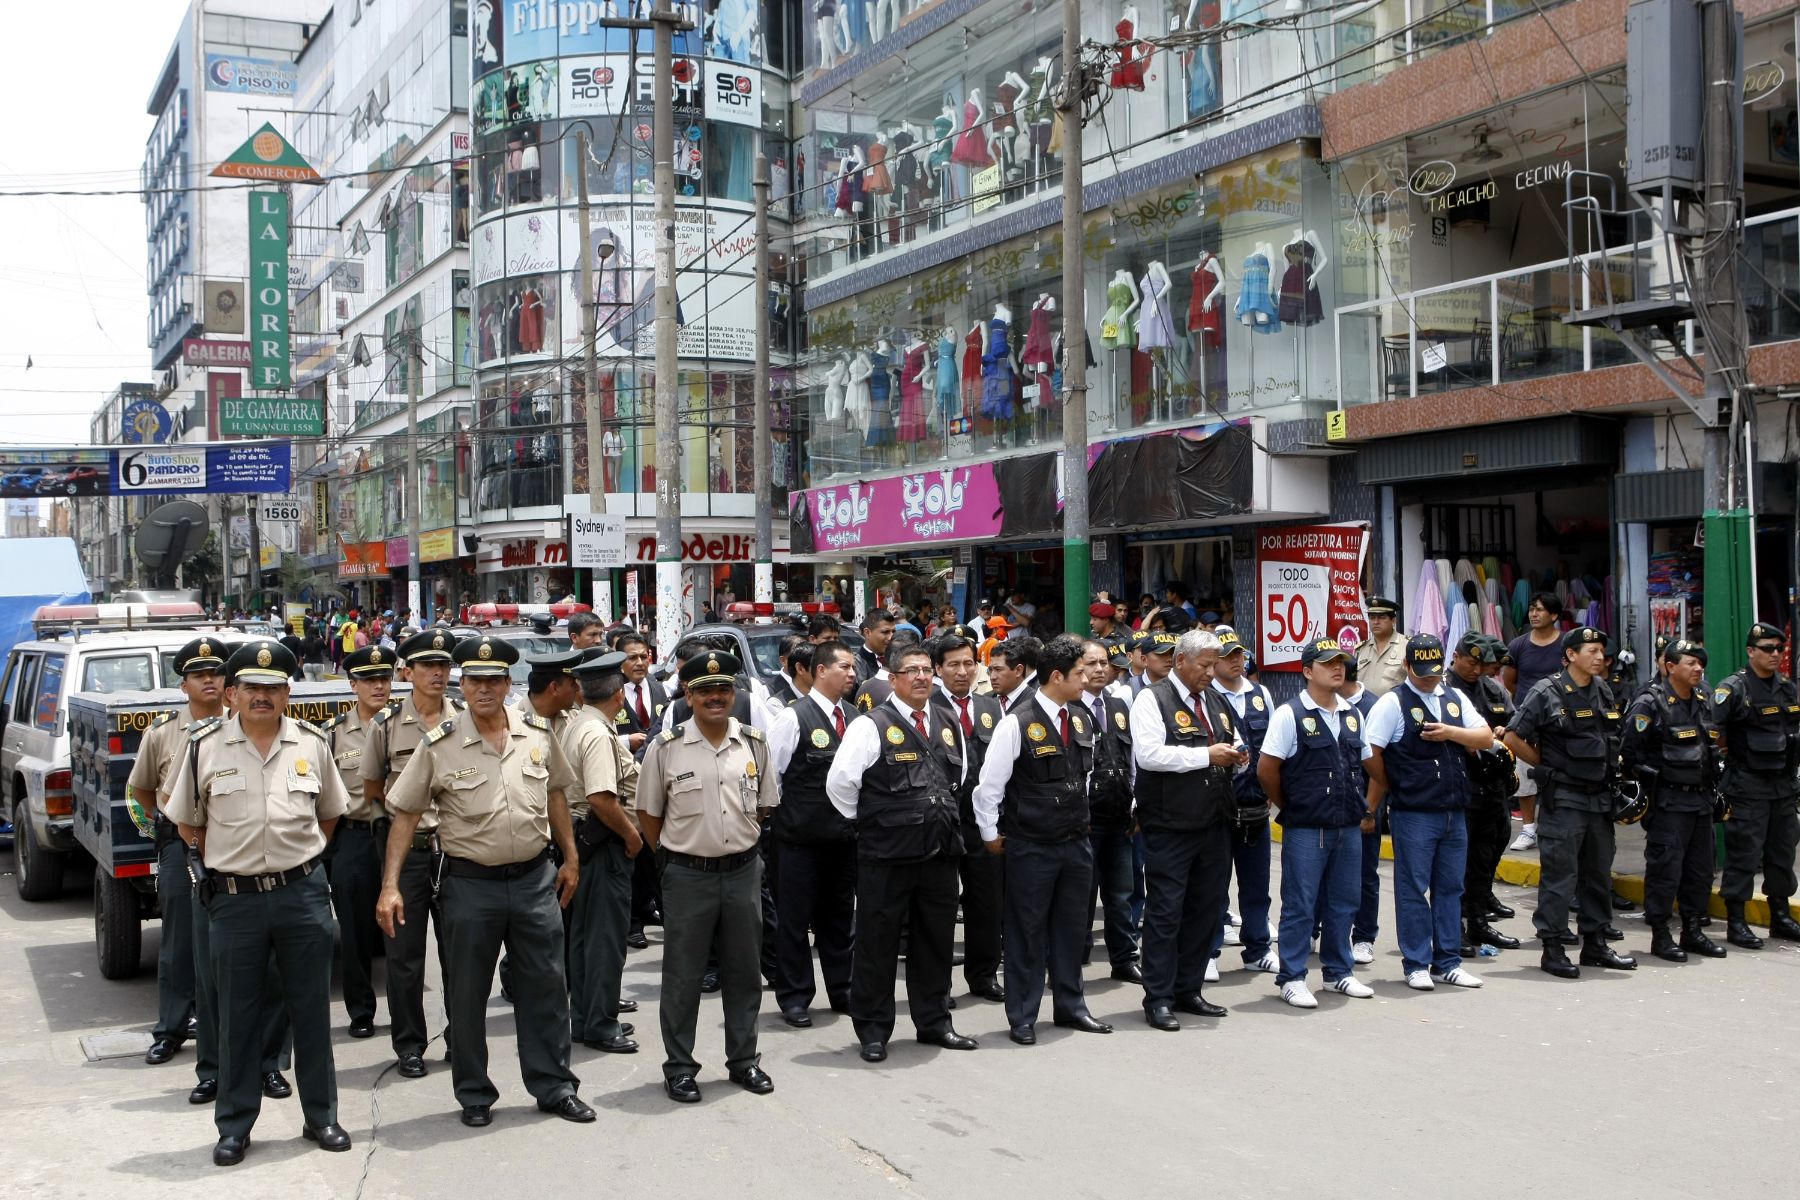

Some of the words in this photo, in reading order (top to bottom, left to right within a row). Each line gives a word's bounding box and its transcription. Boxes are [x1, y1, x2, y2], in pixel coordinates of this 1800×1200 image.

[512, 0, 618, 36] Filippo
[238, 77, 272, 88] PISO
[274, 80, 290, 90] 10
[571, 66, 614, 86] SO
[716, 72, 752, 94] SO
[572, 85, 614, 100] HOT
[636, 75, 699, 103] HT
[717, 91, 752, 107] HOT
[1415, 169, 1454, 192] Open
[1516, 160, 1572, 190] CECINA
[1429, 181, 1496, 212] TACACHO
[260, 196, 280, 240] LA
[508, 253, 556, 274] Alicia
[260, 261, 282, 386] TORRE
[187, 343, 251, 362] GALERIA
[225, 401, 243, 419] DE
[247, 401, 320, 420] GAMARRA
[232, 423, 243, 431] H.
[245, 422, 289, 431] UNANUE
[293, 423, 314, 432] 1558
[148, 453, 200, 465] autoshow
[148, 465, 200, 476] PANDERO
[148, 477, 182, 485] GAMARRA
[183, 476, 200, 484] 2013
[265, 508, 299, 519] 1560
[576, 518, 605, 536] Sydney
[1262, 535, 1282, 549] POR
[1286, 533, 1343, 548] REAPERTURA
[1278, 568, 1309, 582] TODO
[1414, 649, 1442, 661] POLICIA
